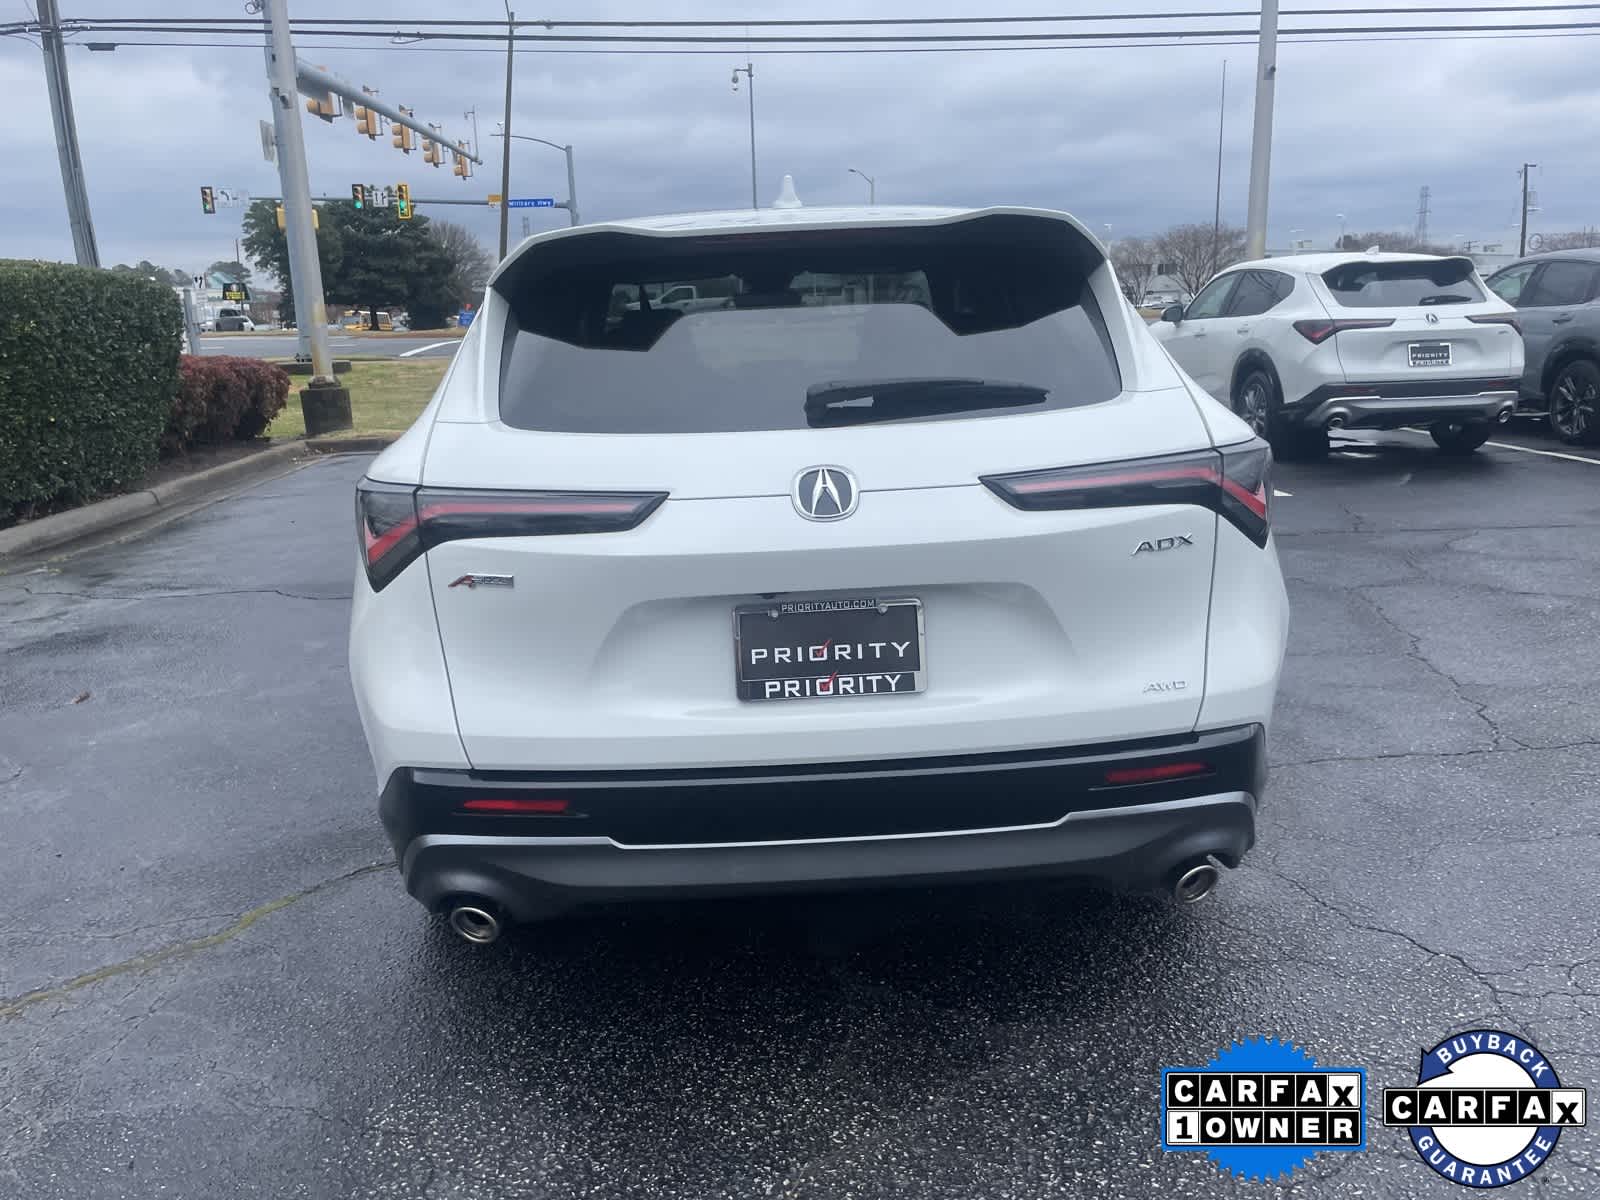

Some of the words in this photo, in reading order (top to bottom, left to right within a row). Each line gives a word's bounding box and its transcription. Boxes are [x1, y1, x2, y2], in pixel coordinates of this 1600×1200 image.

[1133, 533, 1193, 555] ADX
[781, 599, 875, 612] PRIORITYAUTO.COM
[751, 641, 910, 664] PRIORITY
[765, 674, 902, 699] PRIORITY
[1142, 680, 1187, 692] AWD
